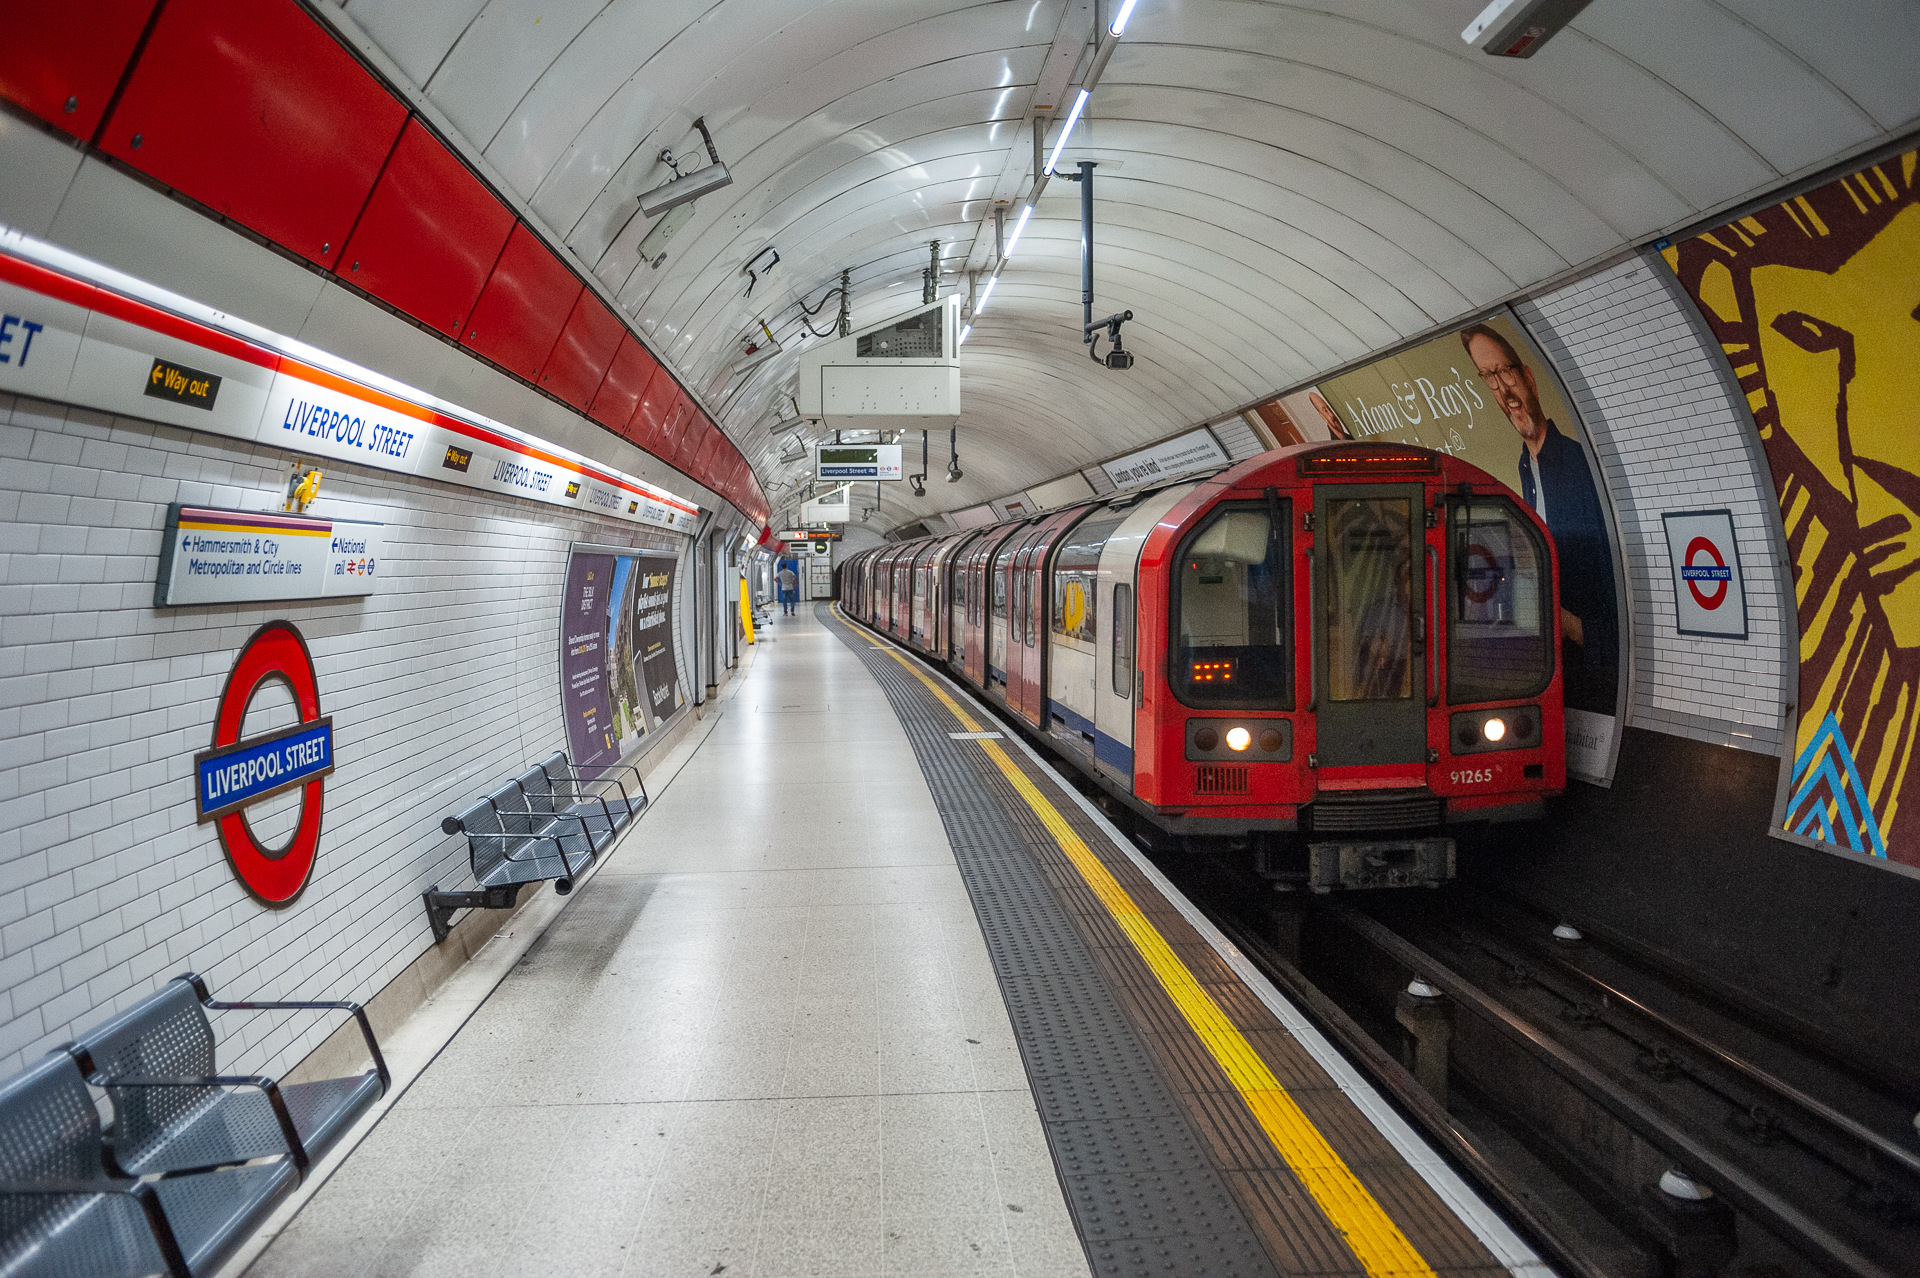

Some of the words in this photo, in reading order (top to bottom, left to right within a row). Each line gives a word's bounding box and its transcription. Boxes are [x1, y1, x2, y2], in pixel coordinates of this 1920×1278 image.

[164, 367, 188, 395] Way
[189, 380, 209, 397] out
[1345, 397, 1403, 438] Adam
[1391, 382, 1422, 425] &
[1414, 367, 1484, 429] Ray's
[283, 398, 366, 448] LIVERPOOL
[368, 423, 414, 458] STREET
[493, 459, 530, 488] LIVERPOOL
[529, 471, 553, 492] STREET
[192, 535, 252, 553] Hammersmith
[254, 540, 260, 553] &
[263, 539, 279, 558] City
[338, 537, 366, 554] National
[188, 558, 245, 578] Metropolitan
[246, 560, 260, 574] and
[262, 559, 284, 574] Circle
[285, 560, 301, 575] lines
[334, 560, 345, 575] rail
[1683, 569, 1710, 577] LIVERPOOL
[1711, 569, 1729, 577] STREET
[207, 751, 284, 800] LIVERPOOL
[285, 736, 325, 772] STREET
[1450, 768, 1492, 785] 91265
